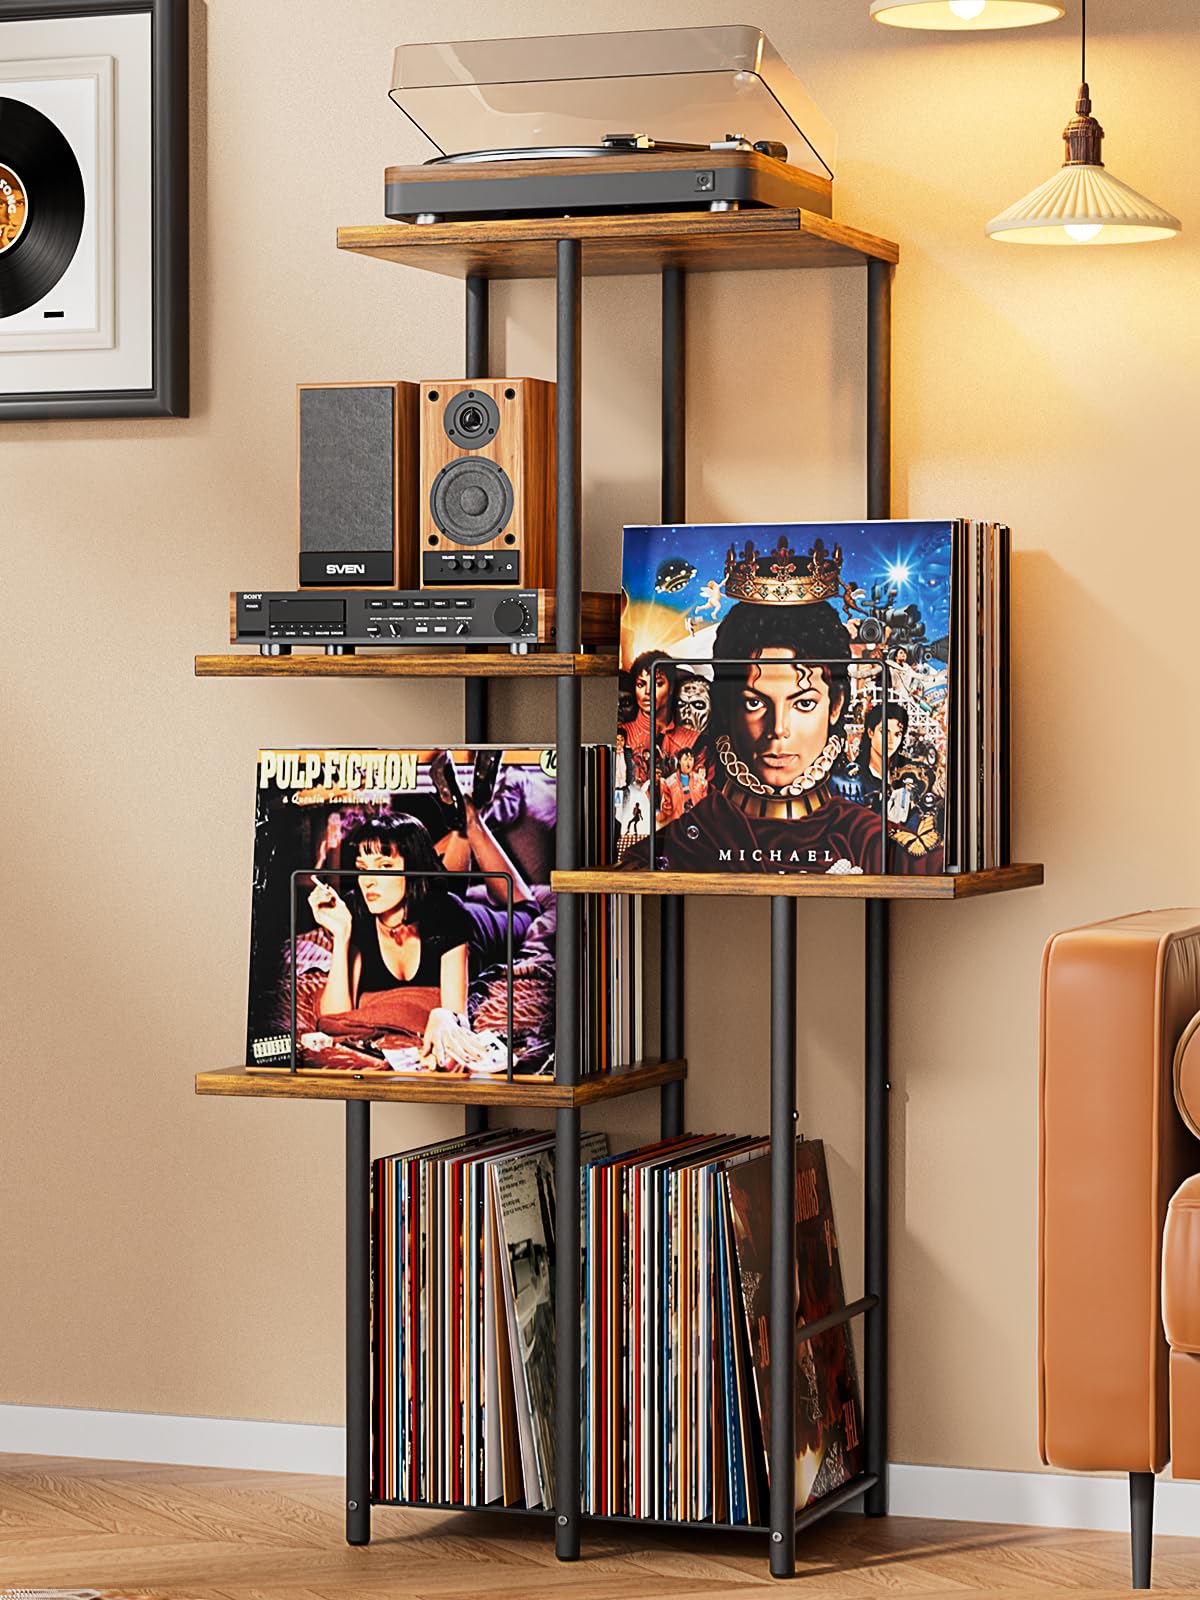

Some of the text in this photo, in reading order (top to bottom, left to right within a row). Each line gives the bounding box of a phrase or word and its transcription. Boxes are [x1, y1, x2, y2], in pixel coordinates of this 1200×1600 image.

[326, 564, 366, 575] SVEN
[259, 751, 418, 791] PULP FICTION
[718, 849, 834, 862] MICHAEL
